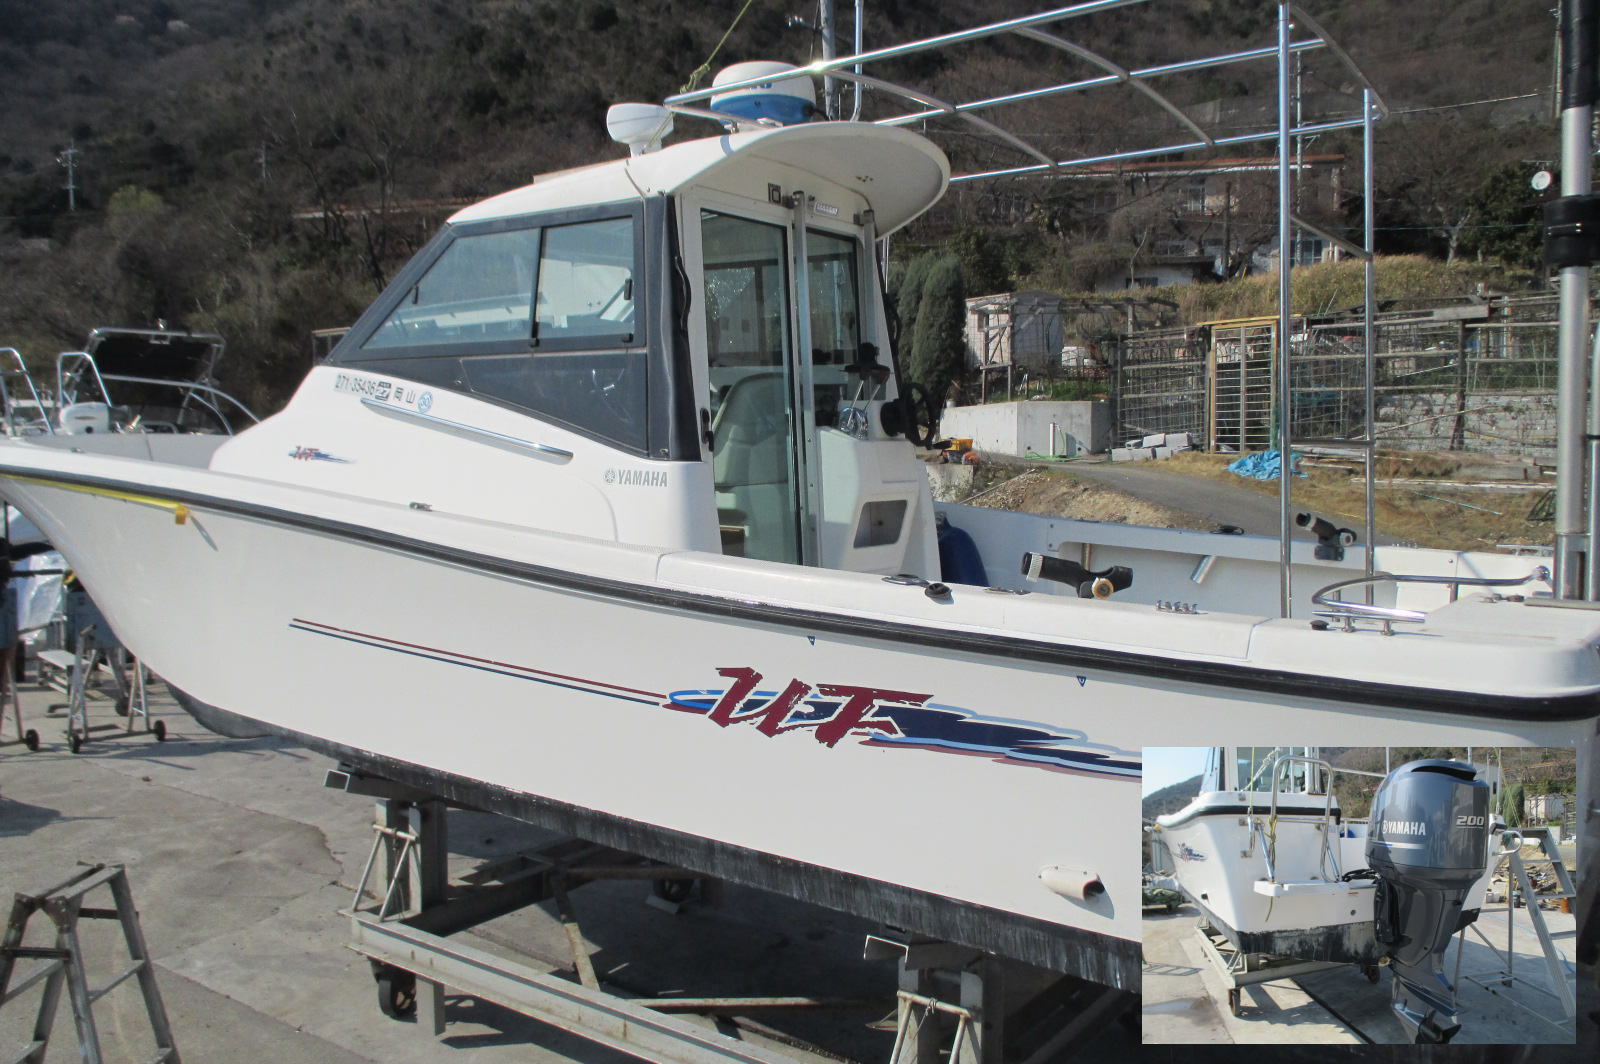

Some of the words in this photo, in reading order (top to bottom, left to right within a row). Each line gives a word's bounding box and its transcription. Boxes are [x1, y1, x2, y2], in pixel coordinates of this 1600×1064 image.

[618, 469, 668, 487] YAMAHA
[1388, 820, 1427, 836] YAMAHA
[1456, 815, 1485, 826] 200
